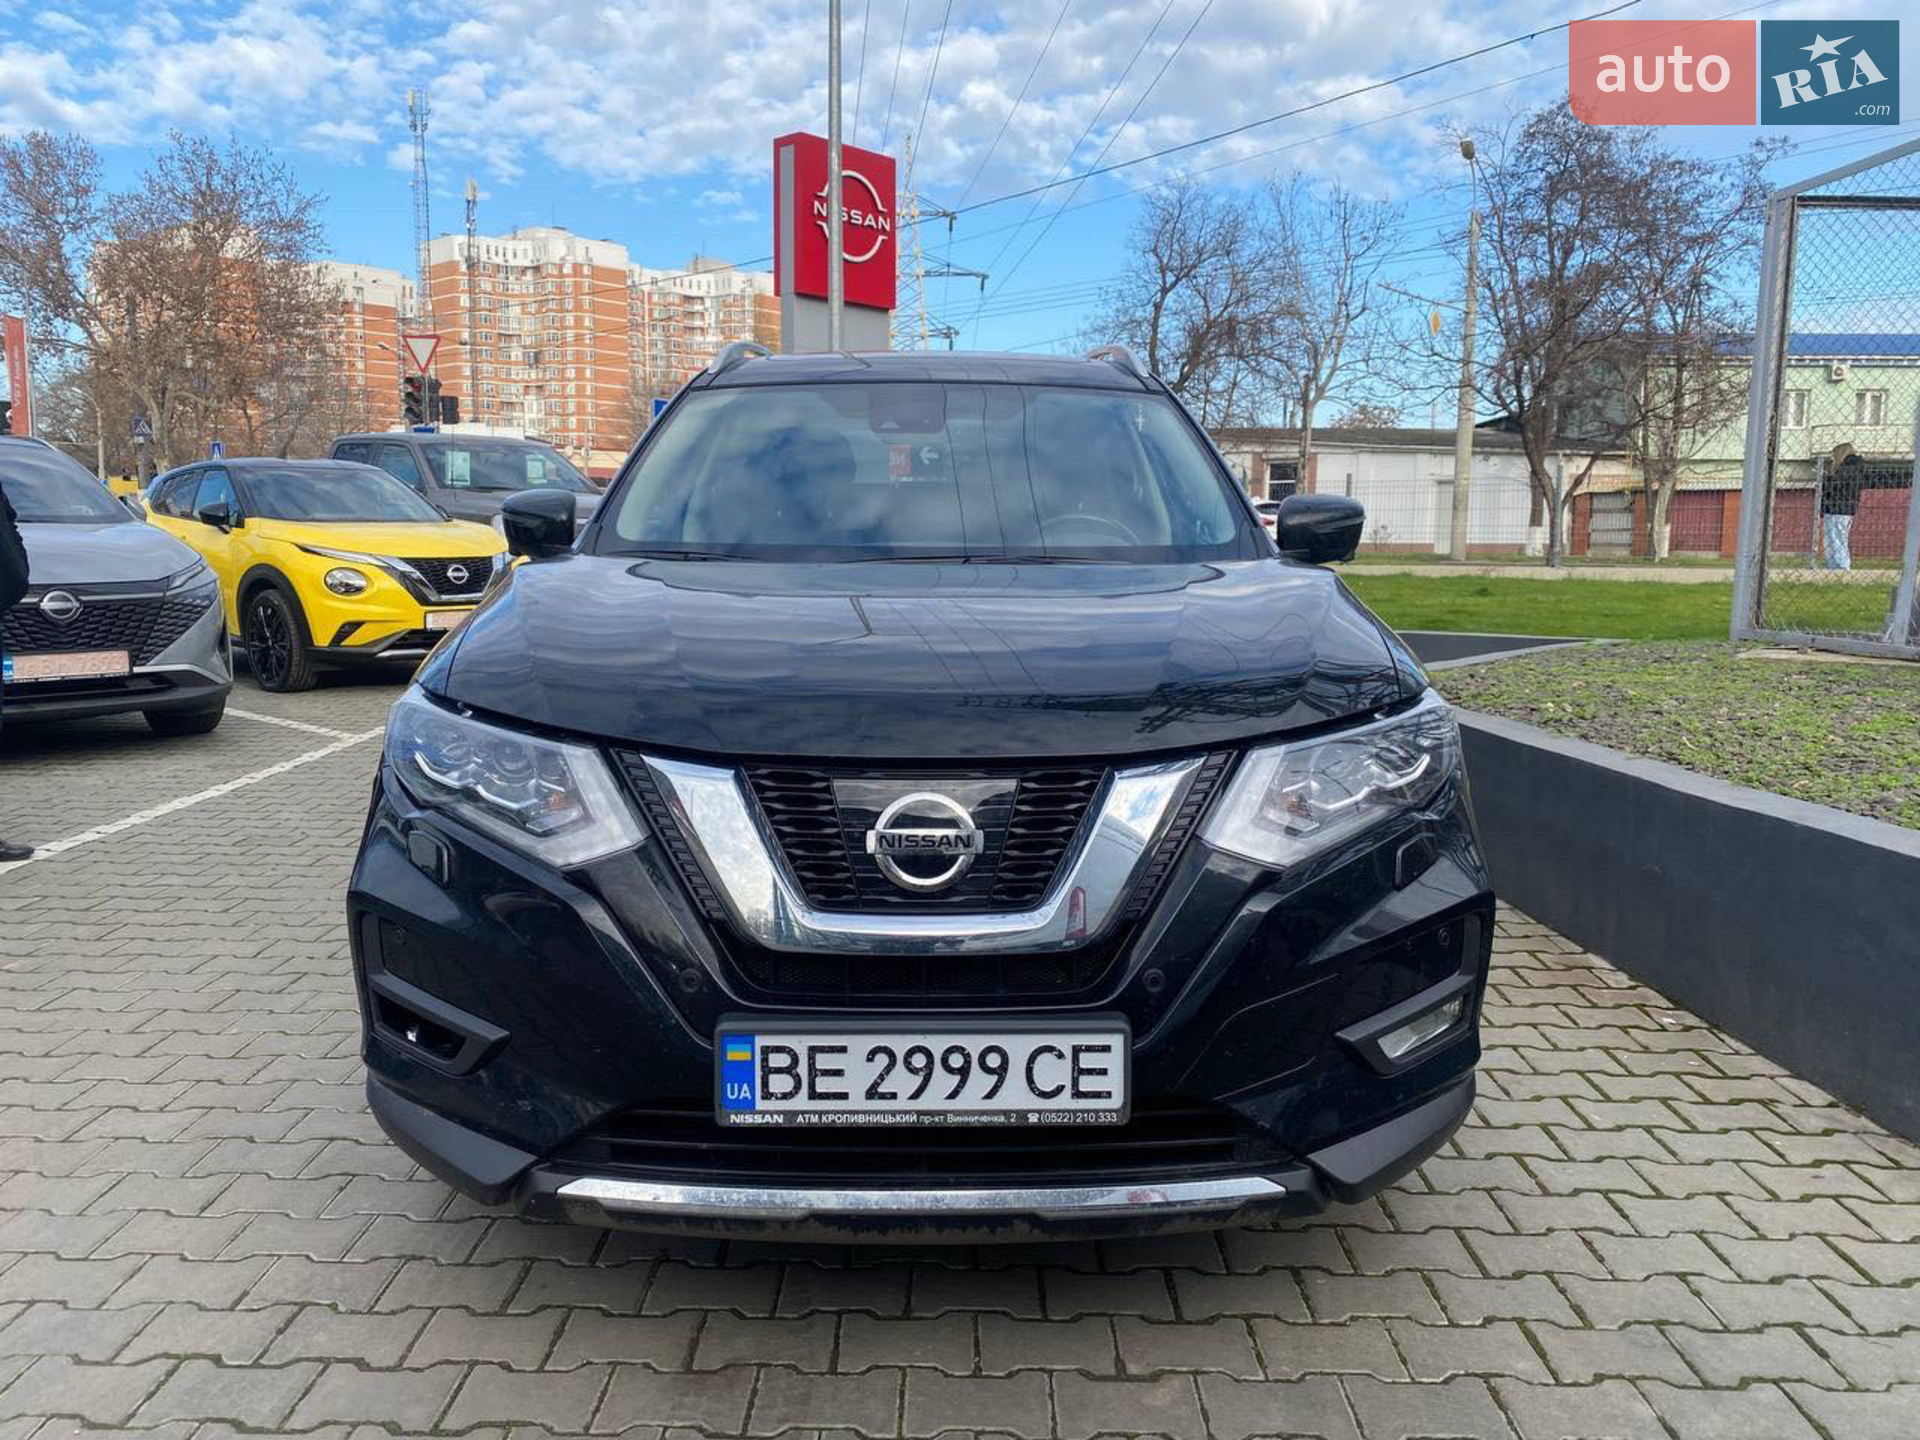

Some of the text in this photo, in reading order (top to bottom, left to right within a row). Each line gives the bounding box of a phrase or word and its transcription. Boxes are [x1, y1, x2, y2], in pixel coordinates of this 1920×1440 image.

[813, 200, 890, 231] NSSAN
[879, 834, 972, 848] NISSAN
[760, 1044, 1112, 1100] BE 2999 CE
[727, 1083, 752, 1100] UA
[730, 1114, 784, 1124] NISSAN
[796, 1114, 819, 1123] АТМ
[821, 1112, 918, 1124] КРОПИВНИЦЬКИЙ
[1010, 1113, 1018, 1123] 2
[1040, 1112, 1074, 1123] (0522)
[1076, 1112, 1095, 1122] 210
[1100, 1112, 1118, 1122] 333
